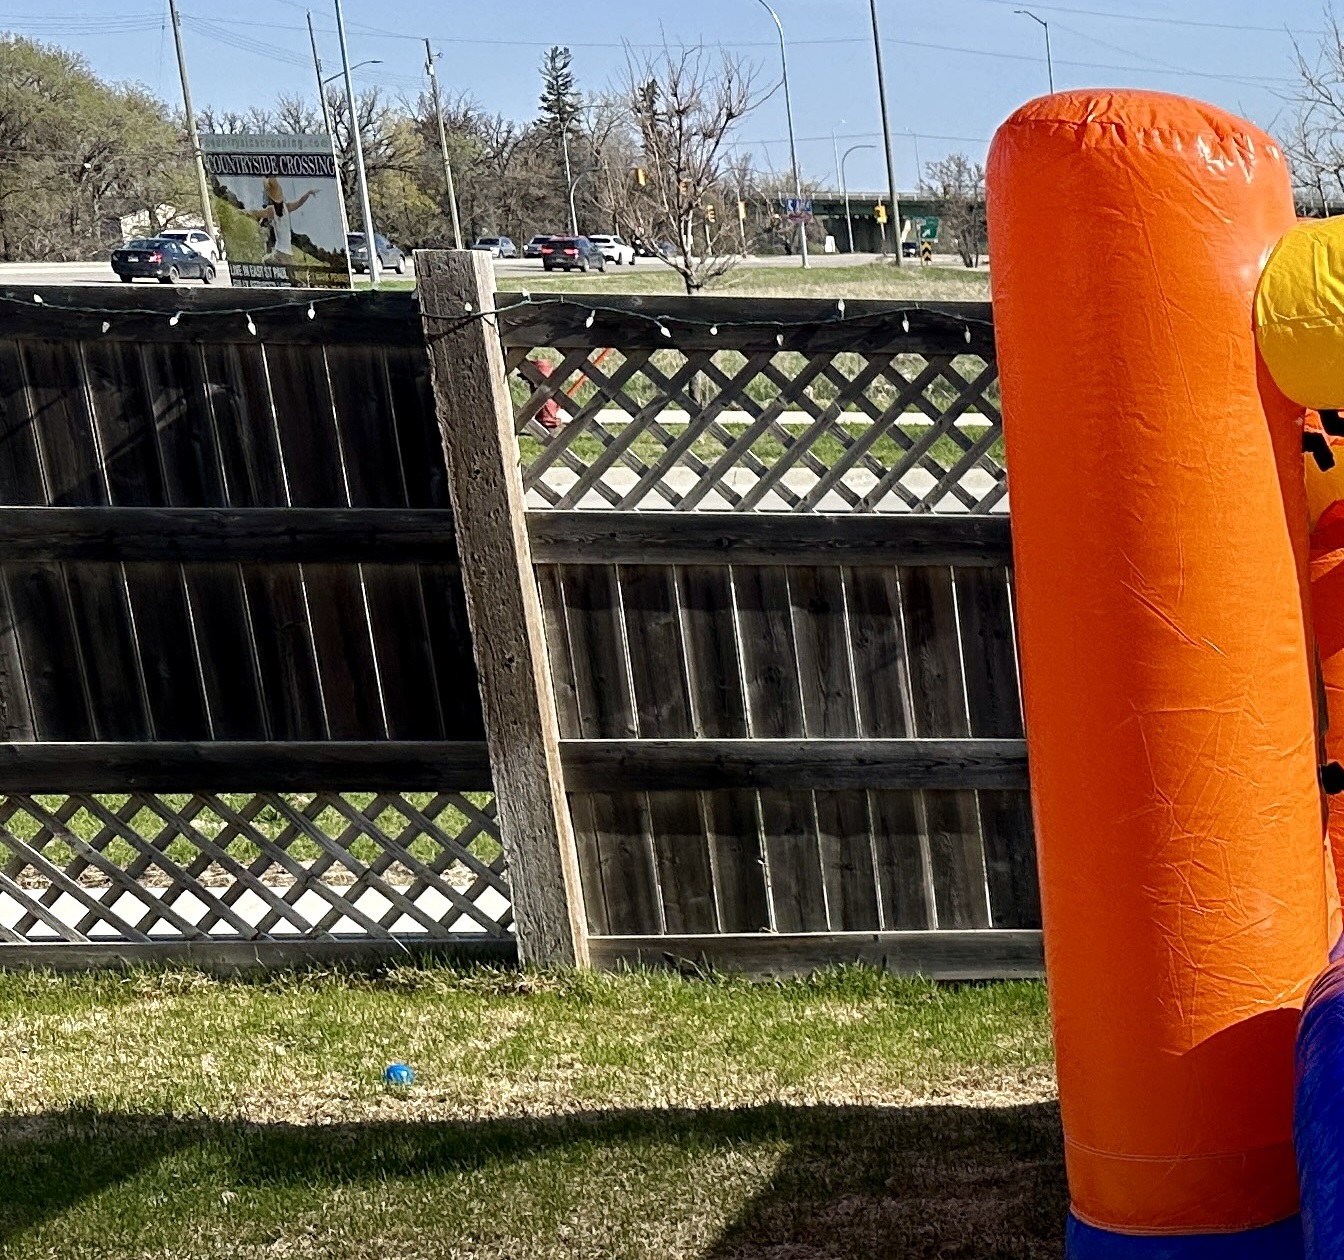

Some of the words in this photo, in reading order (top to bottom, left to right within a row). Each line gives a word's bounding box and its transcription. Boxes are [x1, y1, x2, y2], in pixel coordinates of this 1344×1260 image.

[206, 154, 279, 174] COUNTRYSIDE
[279, 155, 335, 175] CROSSING
[230, 264, 243, 277] LIVE
[250, 265, 264, 278] EAST
